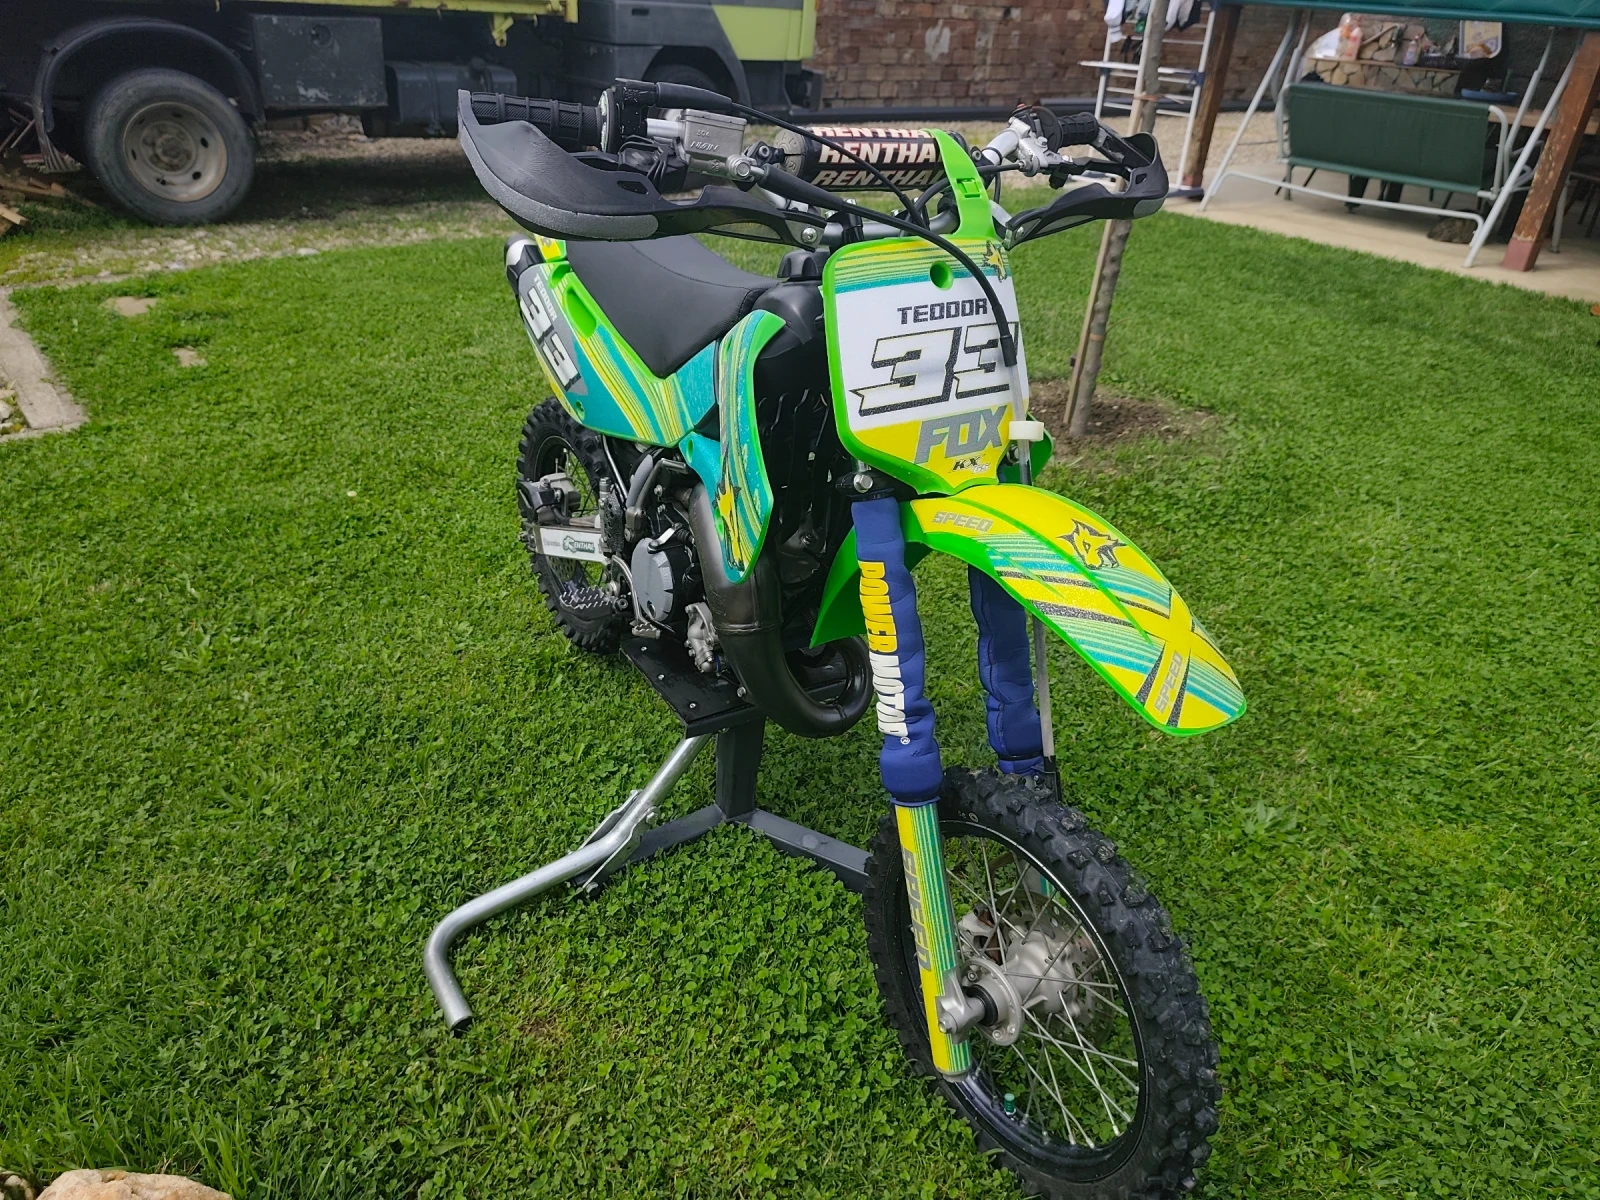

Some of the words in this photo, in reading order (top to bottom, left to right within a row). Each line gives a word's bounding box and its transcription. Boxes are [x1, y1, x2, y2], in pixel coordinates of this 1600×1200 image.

[818, 141, 943, 164] RENTHA
[534, 273, 557, 321] TEODOR
[897, 298, 988, 325] TEODOR
[520, 286, 581, 392] 33
[848, 321, 1019, 417] 33
[914, 404, 1008, 465] FOX
[932, 511, 994, 532] SPEED
[1154, 650, 1183, 715] SPEED
